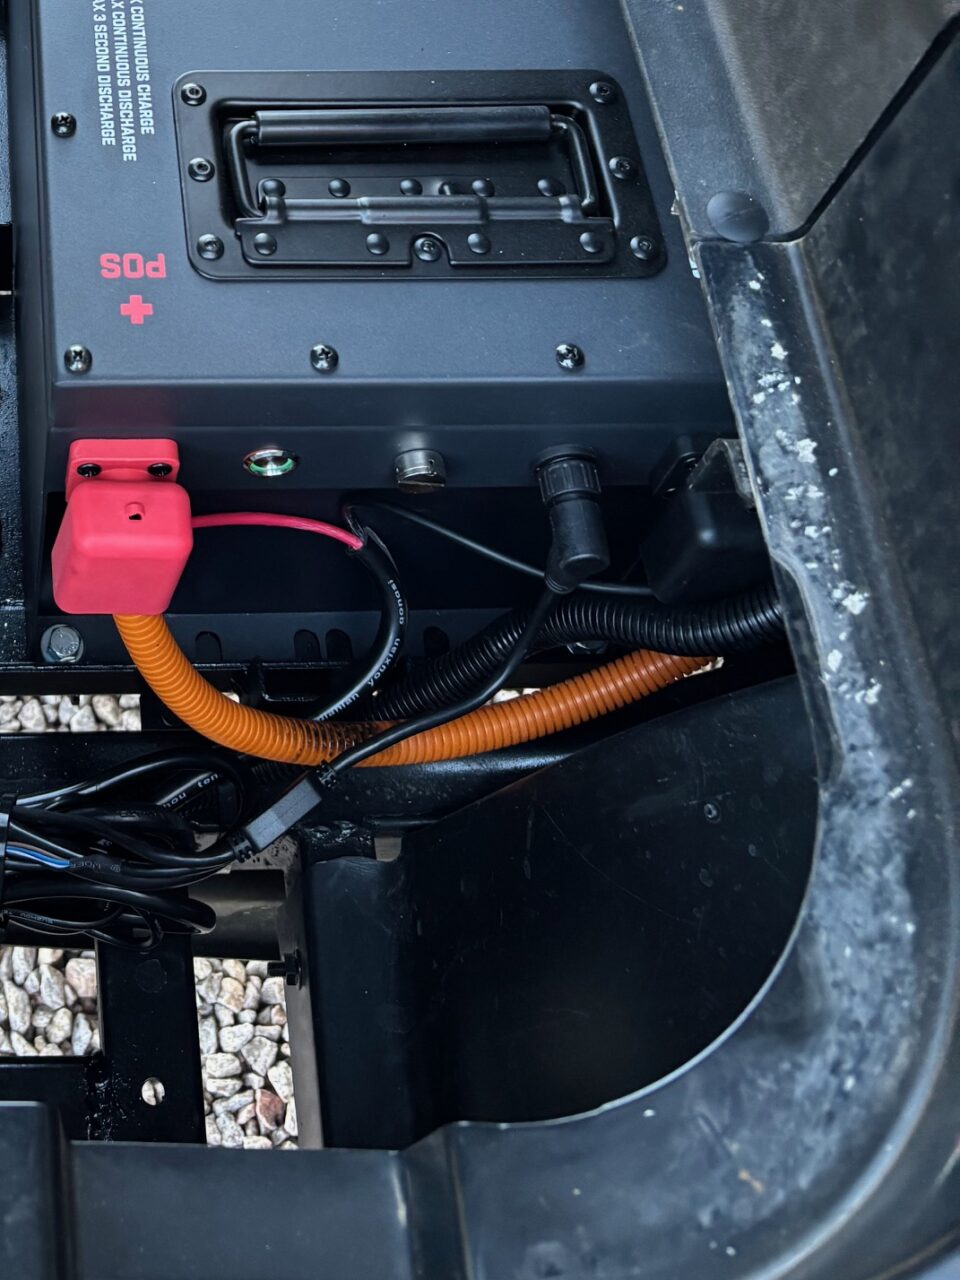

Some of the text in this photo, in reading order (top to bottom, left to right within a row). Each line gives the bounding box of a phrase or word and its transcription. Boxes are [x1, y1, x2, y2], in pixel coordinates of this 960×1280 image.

[94, 14, 106, 22] 3
[94, 24, 109, 71] SECOND
[130, 6, 148, 81] CONTINUOUS
[111, 11, 130, 86] CONTINUOUS
[98, 76, 115, 145] DISCHARGE
[118, 90, 136, 161] DISCHARGE
[137, 84, 154, 135] CHARGE
[100, 252, 166, 279] POS
